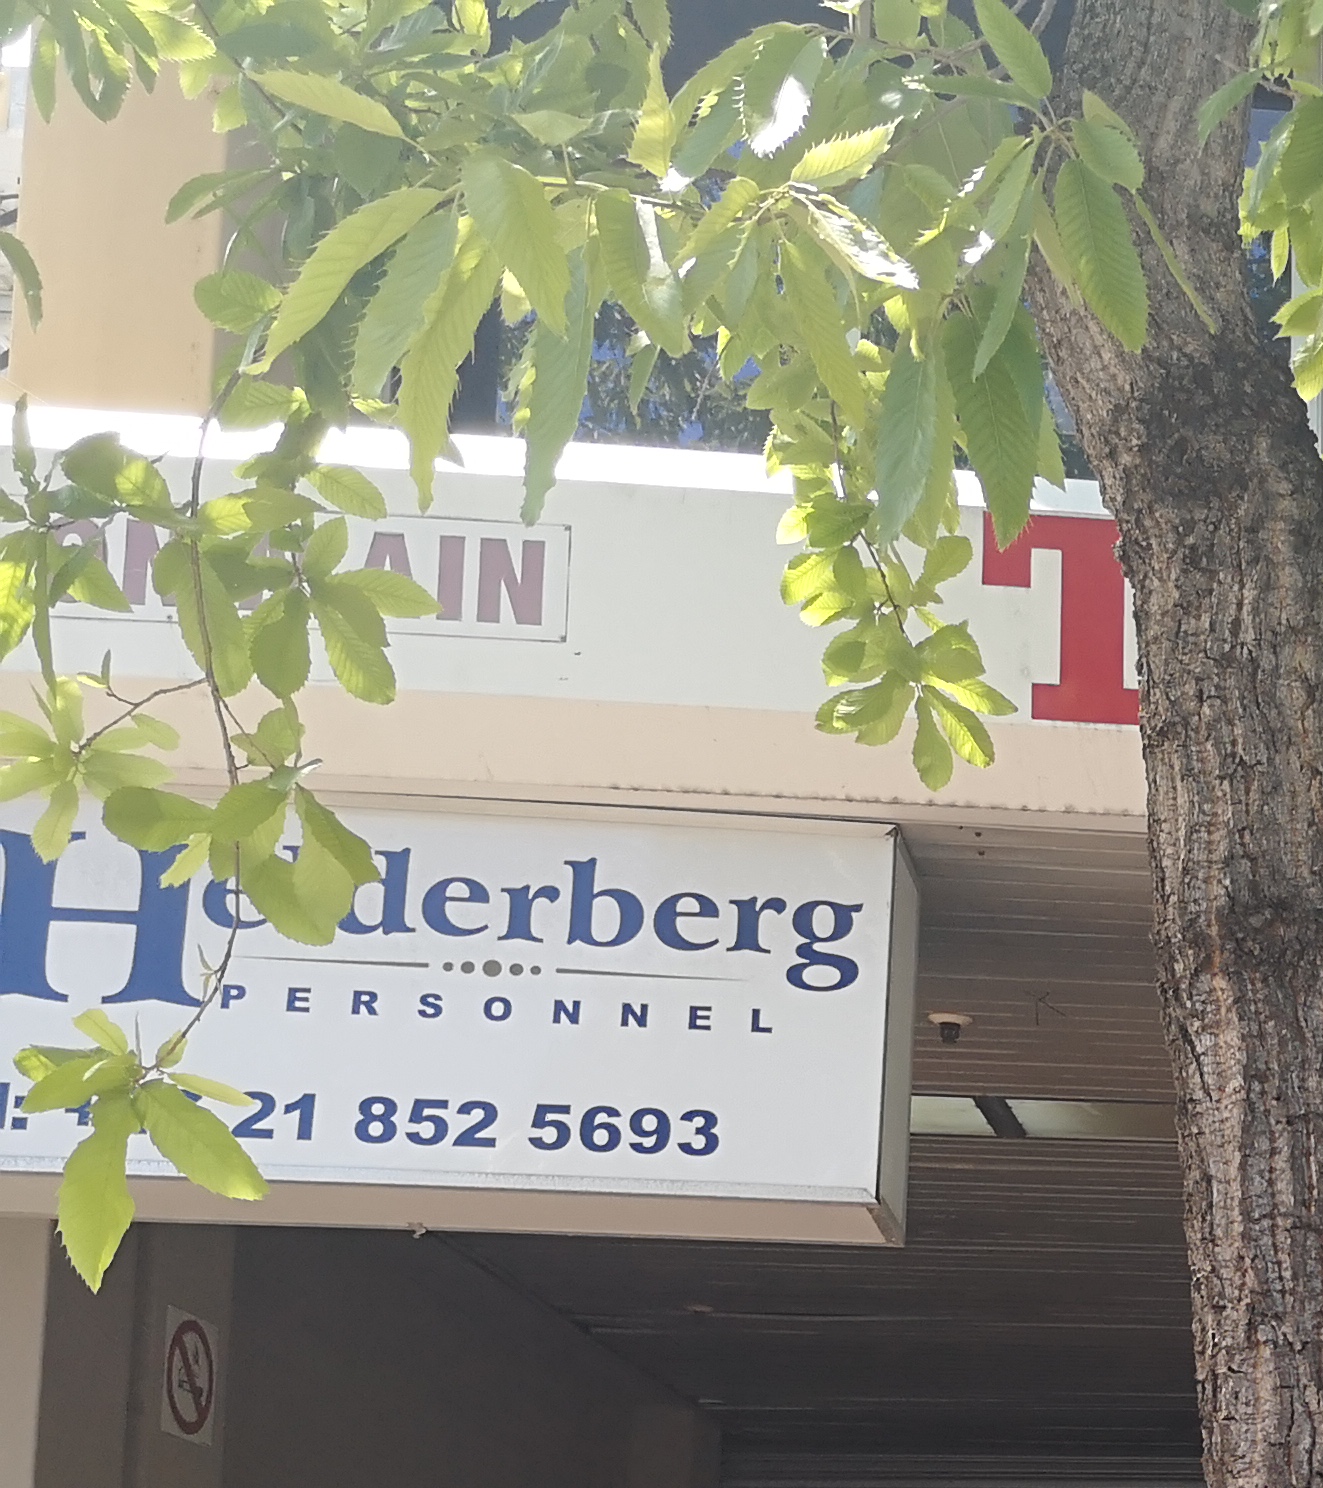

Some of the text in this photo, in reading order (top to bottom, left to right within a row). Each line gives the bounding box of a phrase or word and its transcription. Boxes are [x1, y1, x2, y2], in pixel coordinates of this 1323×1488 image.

[0, 829, 863, 1006] Hederberg
[219, 983, 774, 1034] PERSONNEL
[231, 1091, 317, 1141] 21
[353, 1095, 499, 1147] 852
[527, 1102, 721, 1157] 5693
